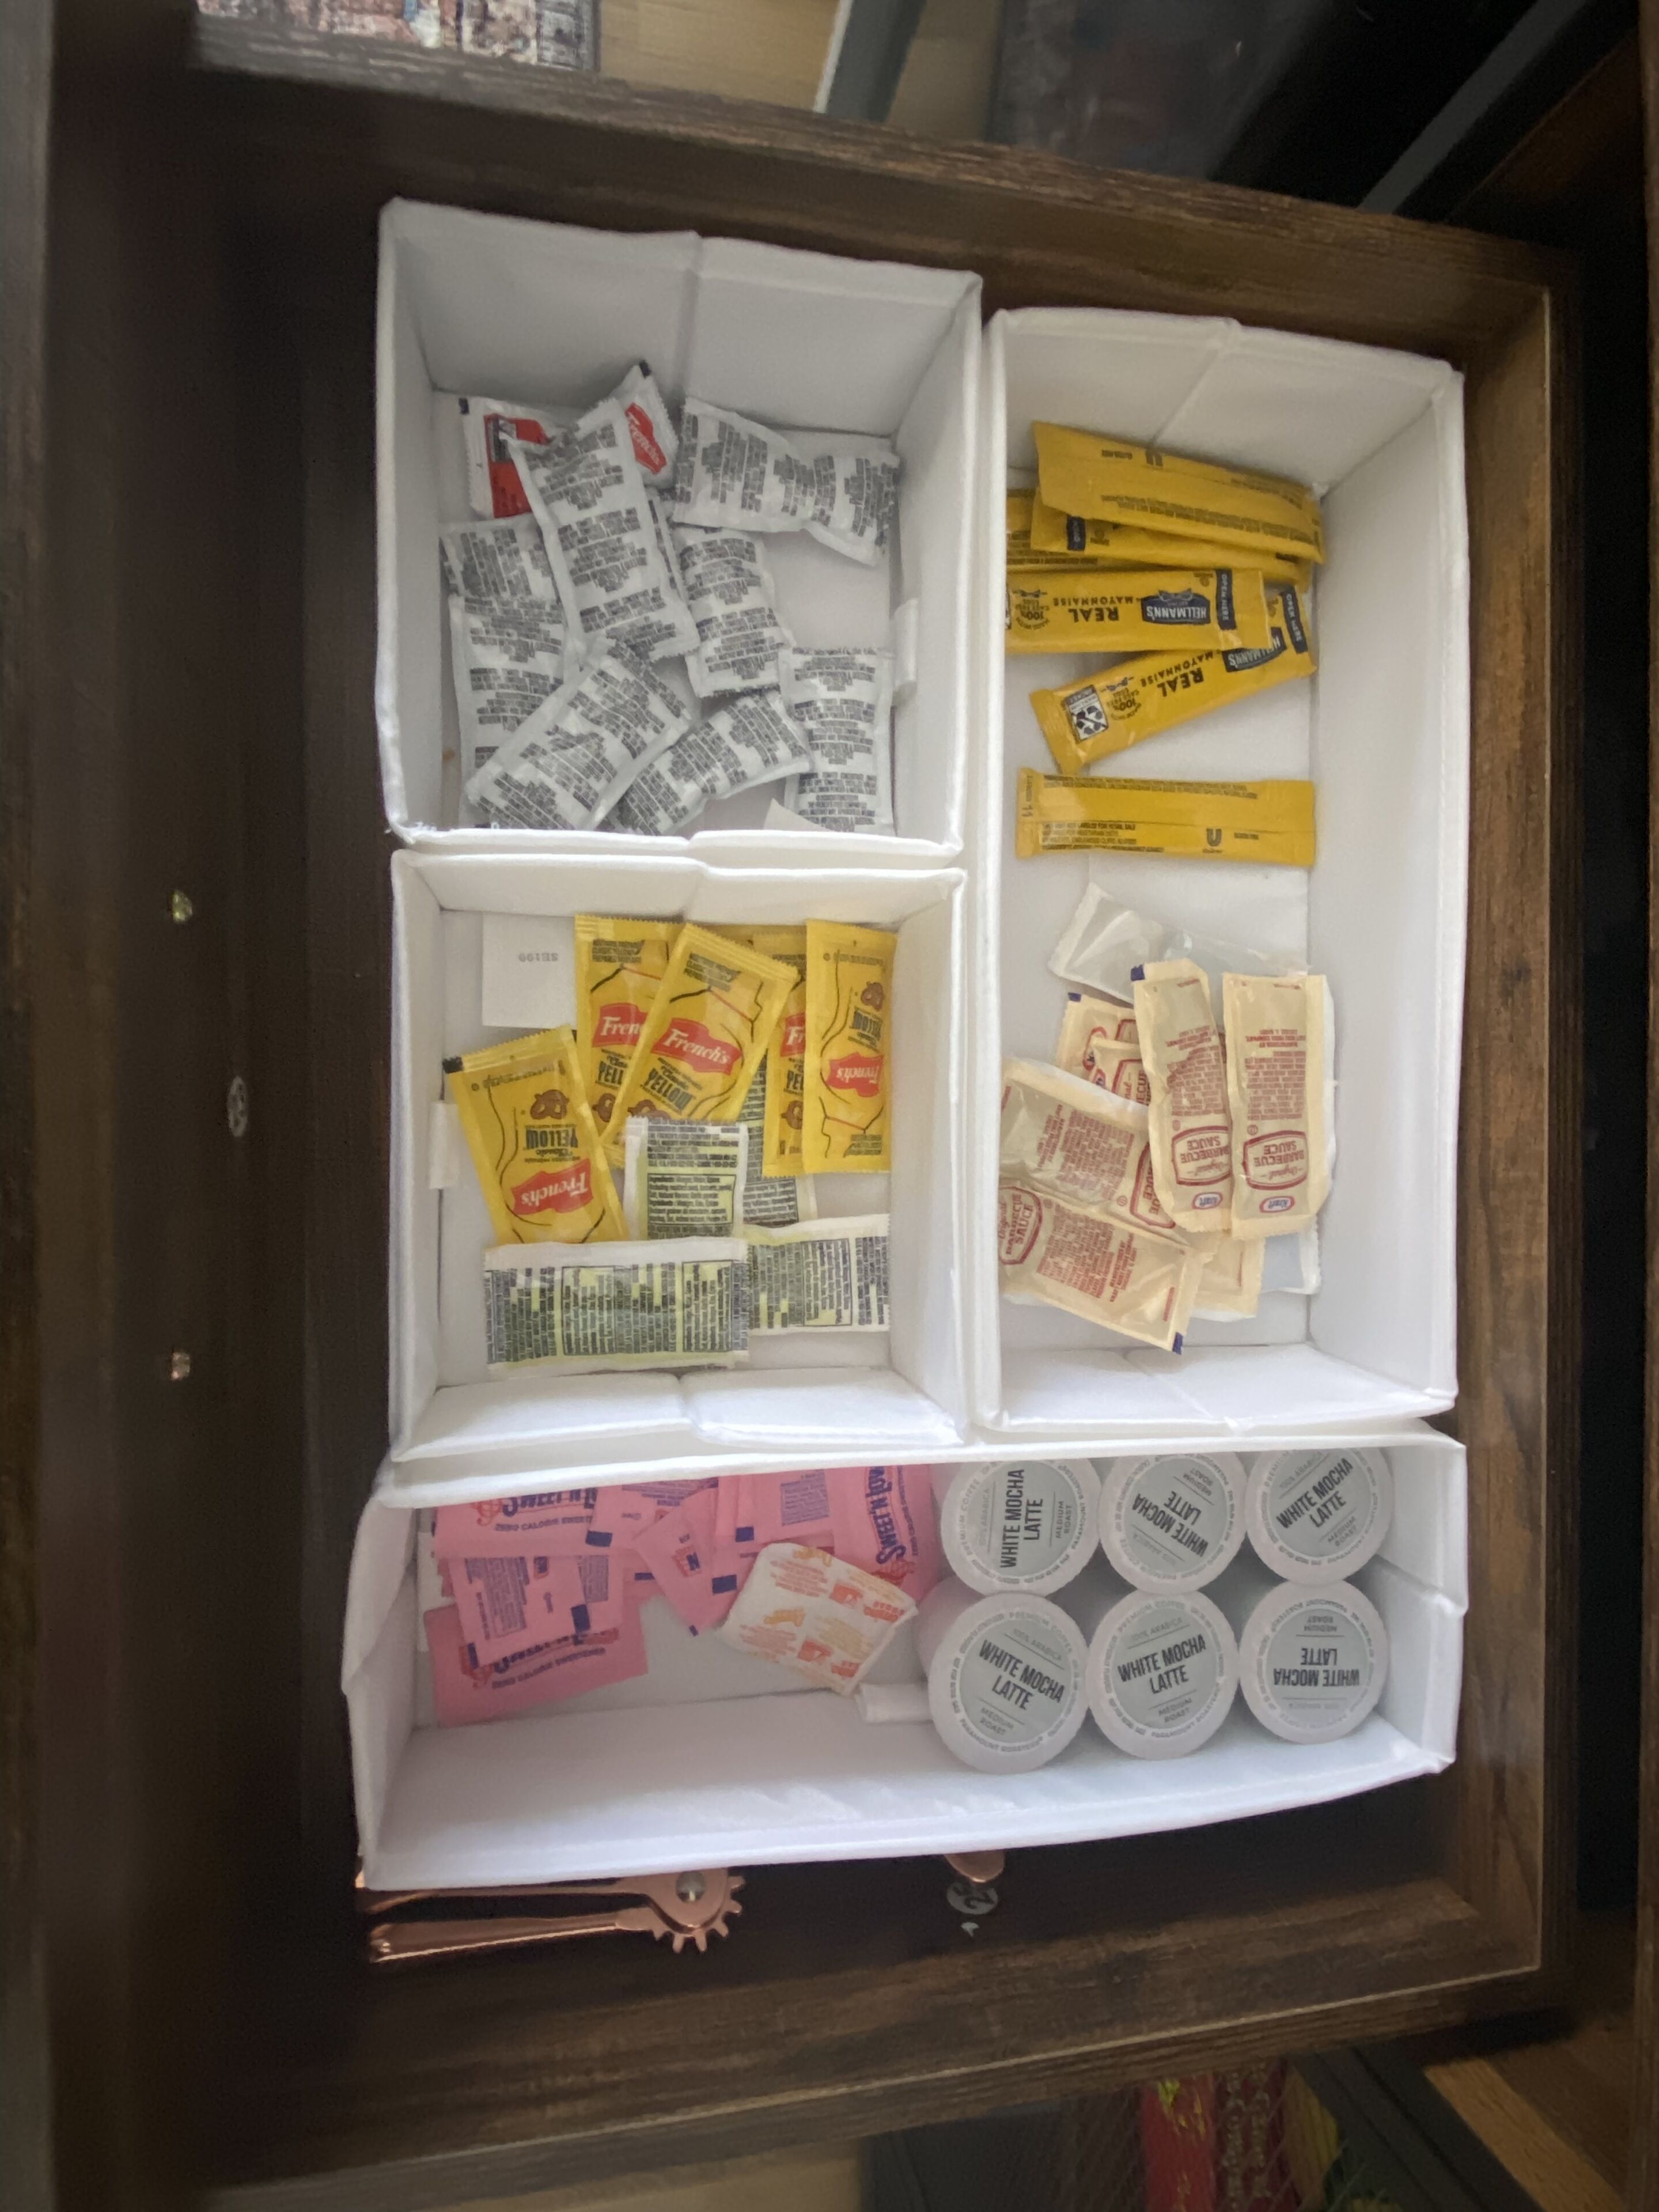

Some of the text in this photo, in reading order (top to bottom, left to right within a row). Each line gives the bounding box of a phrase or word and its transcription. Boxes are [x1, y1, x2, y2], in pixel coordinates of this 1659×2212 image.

[1054, 596, 1133, 606] MAYONNAISE
[1146, 606, 1207, 620] HELLMANN'S
[1286, 593, 1296, 618] OPEN
[1069, 607, 1119, 623] REAL
[1140, 651, 1214, 687] MAYONNAISE
[1157, 667, 1205, 698] REAL
[852, 1009, 882, 1042] YELLOW
[663, 1029, 732, 1065] French's
[598, 1060, 624, 1085] YELL
[836, 1066, 879, 1084] French's
[643, 1067, 696, 1112] YELLOW
[525, 1128, 578, 1150] YELLOW
[1187, 1136, 1221, 1151] SAUCE
[1264, 1141, 1297, 1155] SAUCE
[1180, 1145, 1231, 1164] BARBECUE
[1253, 1150, 1305, 1167] BARBECUE
[521, 1172, 589, 1207] French's
[1199, 1196, 1218, 1207] Kraft
[1268, 1199, 1289, 1209] Kraft
[1006, 1194, 1022, 1255] BARBECUE
[1015, 1203, 1033, 1244] SAUCE
[1183, 1473, 1213, 1496] MEDIUM
[1190, 1468, 1213, 1486] ROAST
[960, 1478, 980, 1511] COFFEE
[1275, 1457, 1353, 1529] WHITE MOCHA
[1000, 1469, 1024, 1568] WHITE MOCHA
[1023, 1498, 1043, 1540] LATTE
[1056, 1500, 1064, 1539] MEDIUM
[1064, 1505, 1073, 1534] ROAST
[1163, 1490, 1202, 1526] LATTE
[1309, 1490, 1346, 1528] LATTE
[1072, 1502, 1086, 1550] PARAMOUNT
[1132, 1493, 1209, 1557] WHITE MOCHA
[1327, 1516, 1356, 1543] MEDIUM
[1334, 1525, 1357, 1547] ROAST
[1307, 1615, 1334, 1623] ROAST
[1118, 1634, 1207, 1682] WHITE MOCHA
[1300, 1647, 1338, 1665] LATTE
[979, 1639, 1065, 1703] WHITE MOCHA
[1149, 1665, 1189, 1694] LATTE
[1274, 1668, 1360, 1687] WHITE MOCHA
[992, 1675, 1033, 1710] LATTE
[980, 1707, 1014, 1730] MEDIUM
[1158, 1698, 1192, 1715] MEDIUM
[1164, 1707, 1190, 1723] ROAST
[960, 1718, 999, 1751] PARAMOUNT
[979, 1718, 1006, 1736] ROAST
[1151, 1722, 1195, 1738] PARAMOUNT
